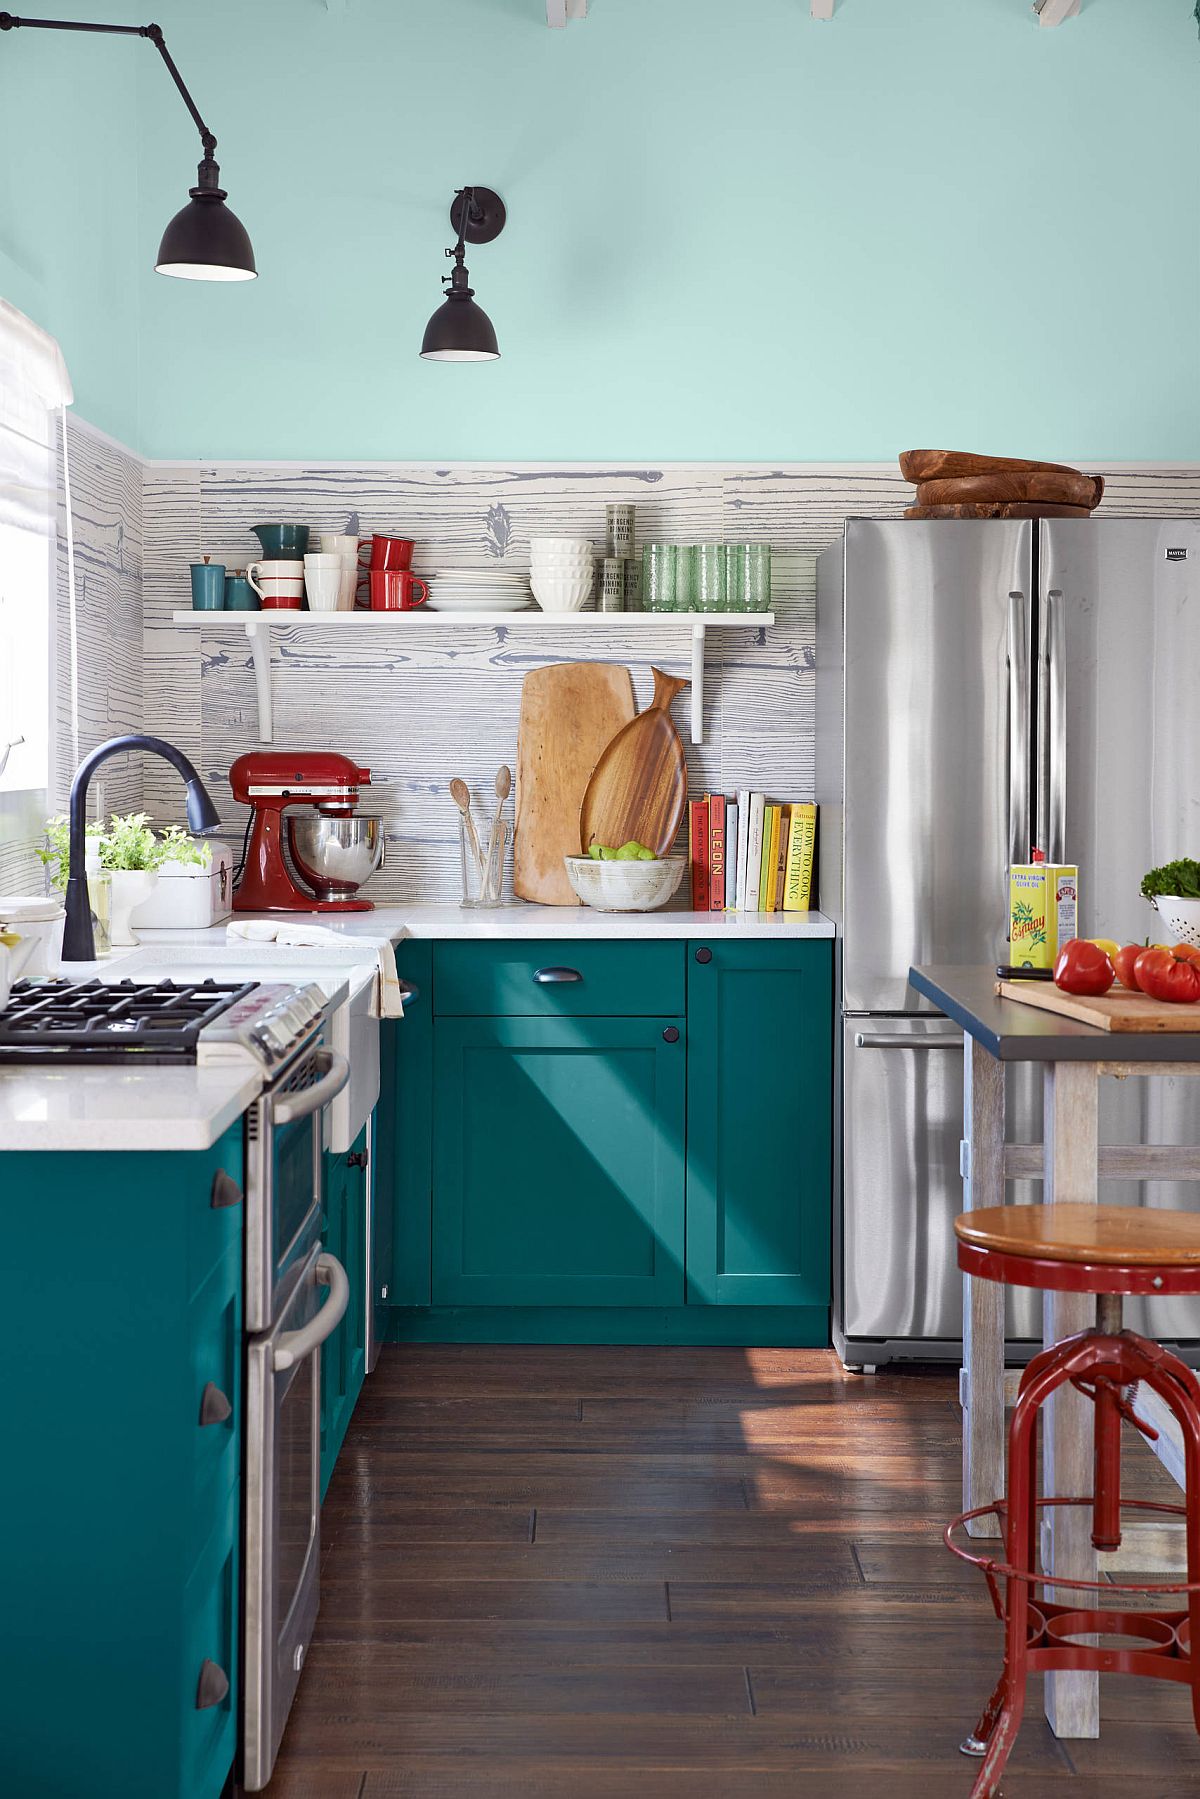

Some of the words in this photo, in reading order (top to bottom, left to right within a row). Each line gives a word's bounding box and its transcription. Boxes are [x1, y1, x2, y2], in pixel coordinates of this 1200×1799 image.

[804, 821, 814, 848] HOW
[712, 828, 723, 876] LEON
[789, 821, 804, 899] EVERYTHING
[803, 850, 812, 867] TO
[800, 869, 811, 900] COOK
